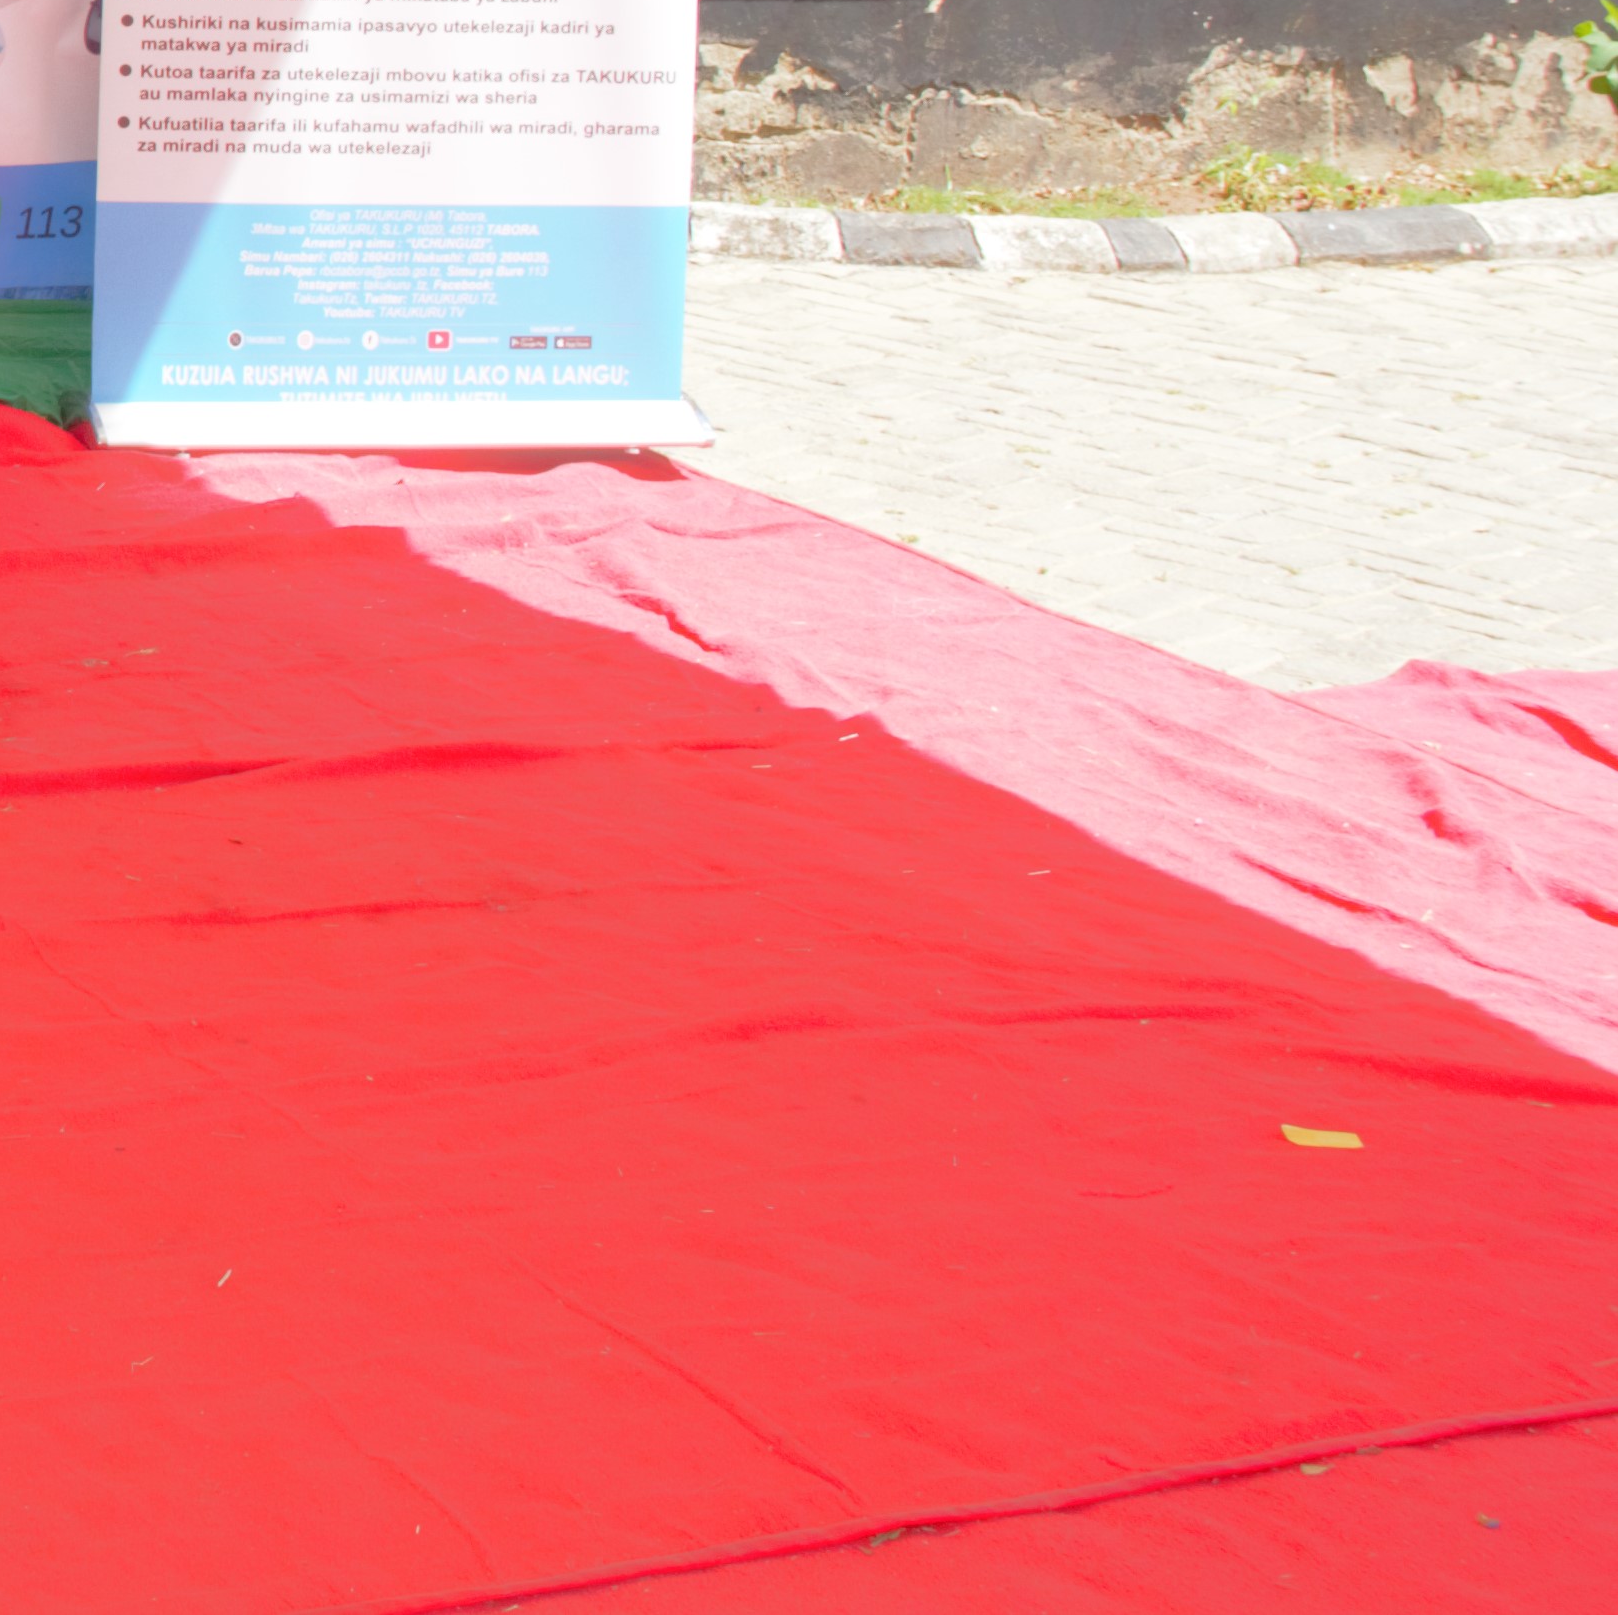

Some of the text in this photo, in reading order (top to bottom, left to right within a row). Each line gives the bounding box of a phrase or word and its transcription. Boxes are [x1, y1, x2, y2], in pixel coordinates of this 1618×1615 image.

[140, 64, 676, 85] Kutoa taarifa za utekelezaji mbovu katika ofisi za TAKUKURU
[138, 116, 224, 132] Kufuatilia
[229, 118, 286, 132] taarifa
[292, 119, 307, 132] ili
[313, 119, 400, 134] kufahamu
[405, 120, 484, 134] wafadhili
[489, 123, 513, 134] wa
[583, 121, 660, 139] gharama
[137, 139, 431, 159] za miradi na muda wa utekelezaji
[15, 205, 84, 240] 113
[161, 364, 237, 387] KUZUIA
[242, 364, 331, 386] RUSHWA
[335, 364, 359, 385] NI
[363, 364, 448, 387] JUKUMU
[453, 365, 510, 386] LAKO
[514, 365, 548, 385] NA
